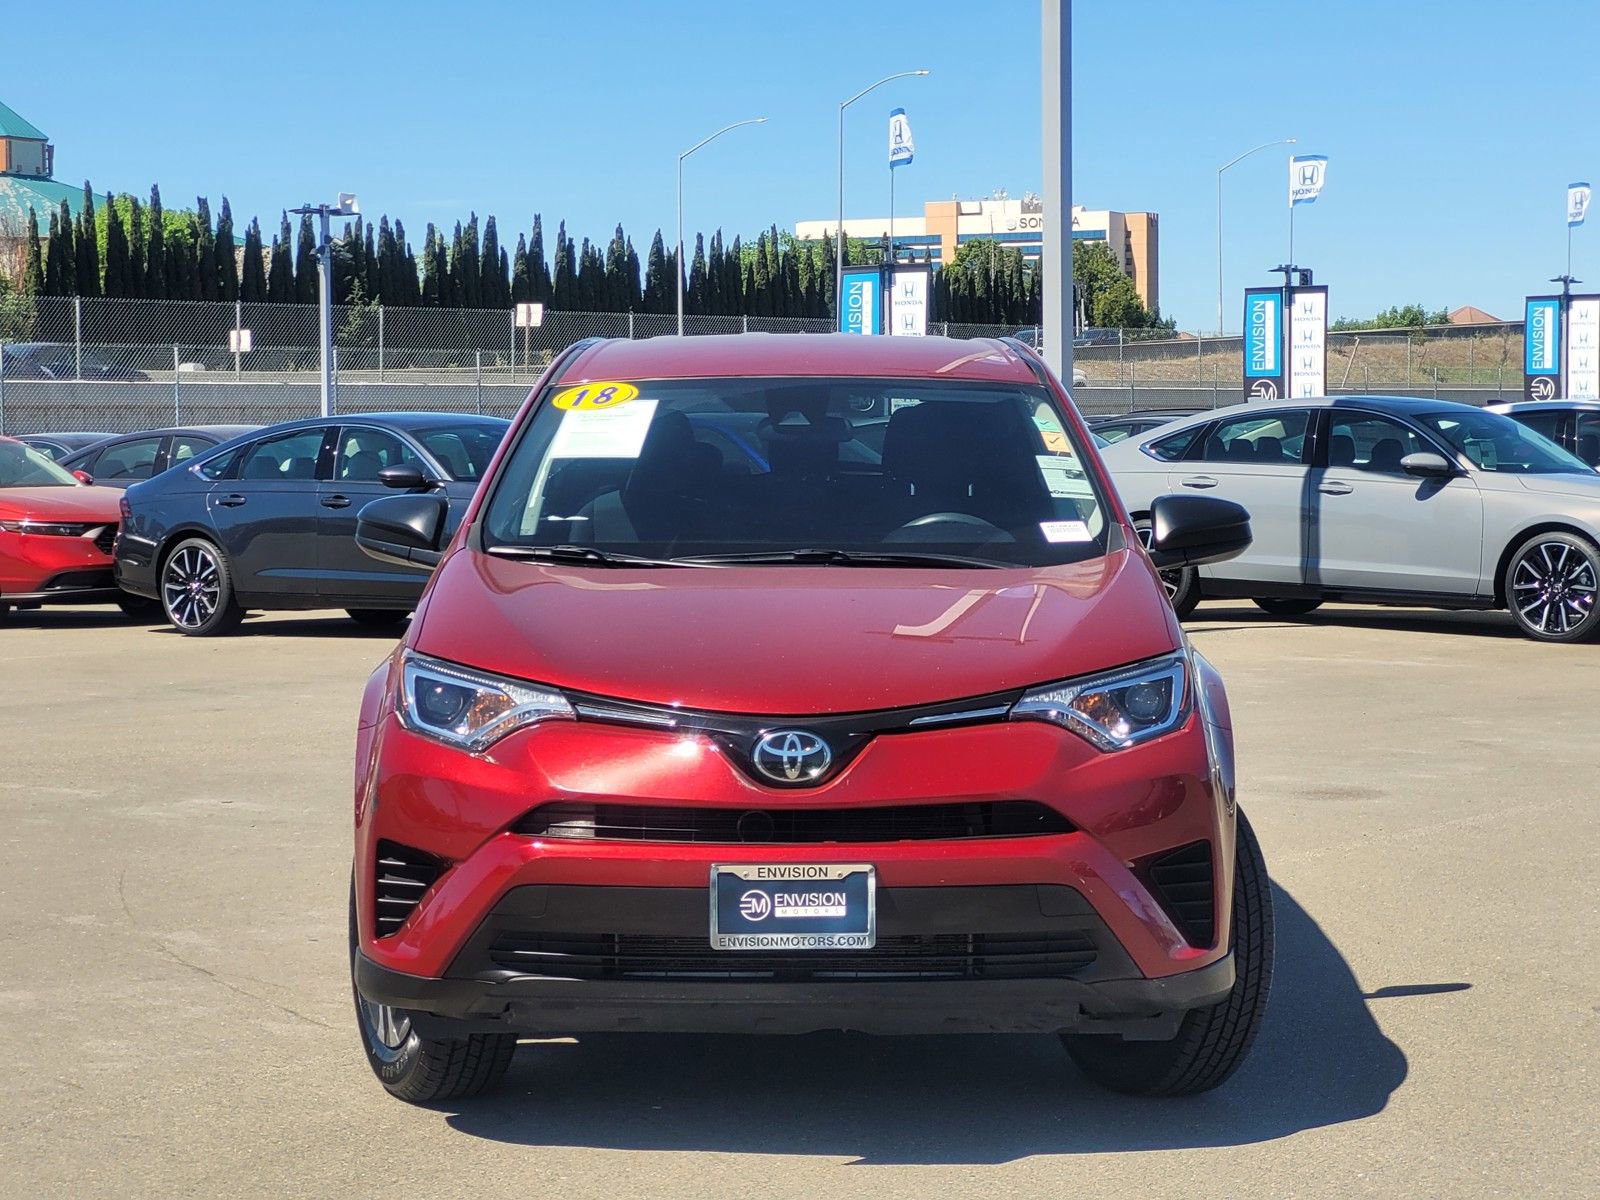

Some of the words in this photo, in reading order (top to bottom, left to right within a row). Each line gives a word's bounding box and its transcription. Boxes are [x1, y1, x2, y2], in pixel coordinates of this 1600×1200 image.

[1252, 300, 1265, 371] ENVISION
[1532, 307, 1544, 369] ENVISION
[571, 386, 619, 407] 18
[757, 866, 829, 879] ENVISION
[774, 892, 846, 907] ENVISION
[719, 936, 867, 947] ENVISIONMOTORS.COM
